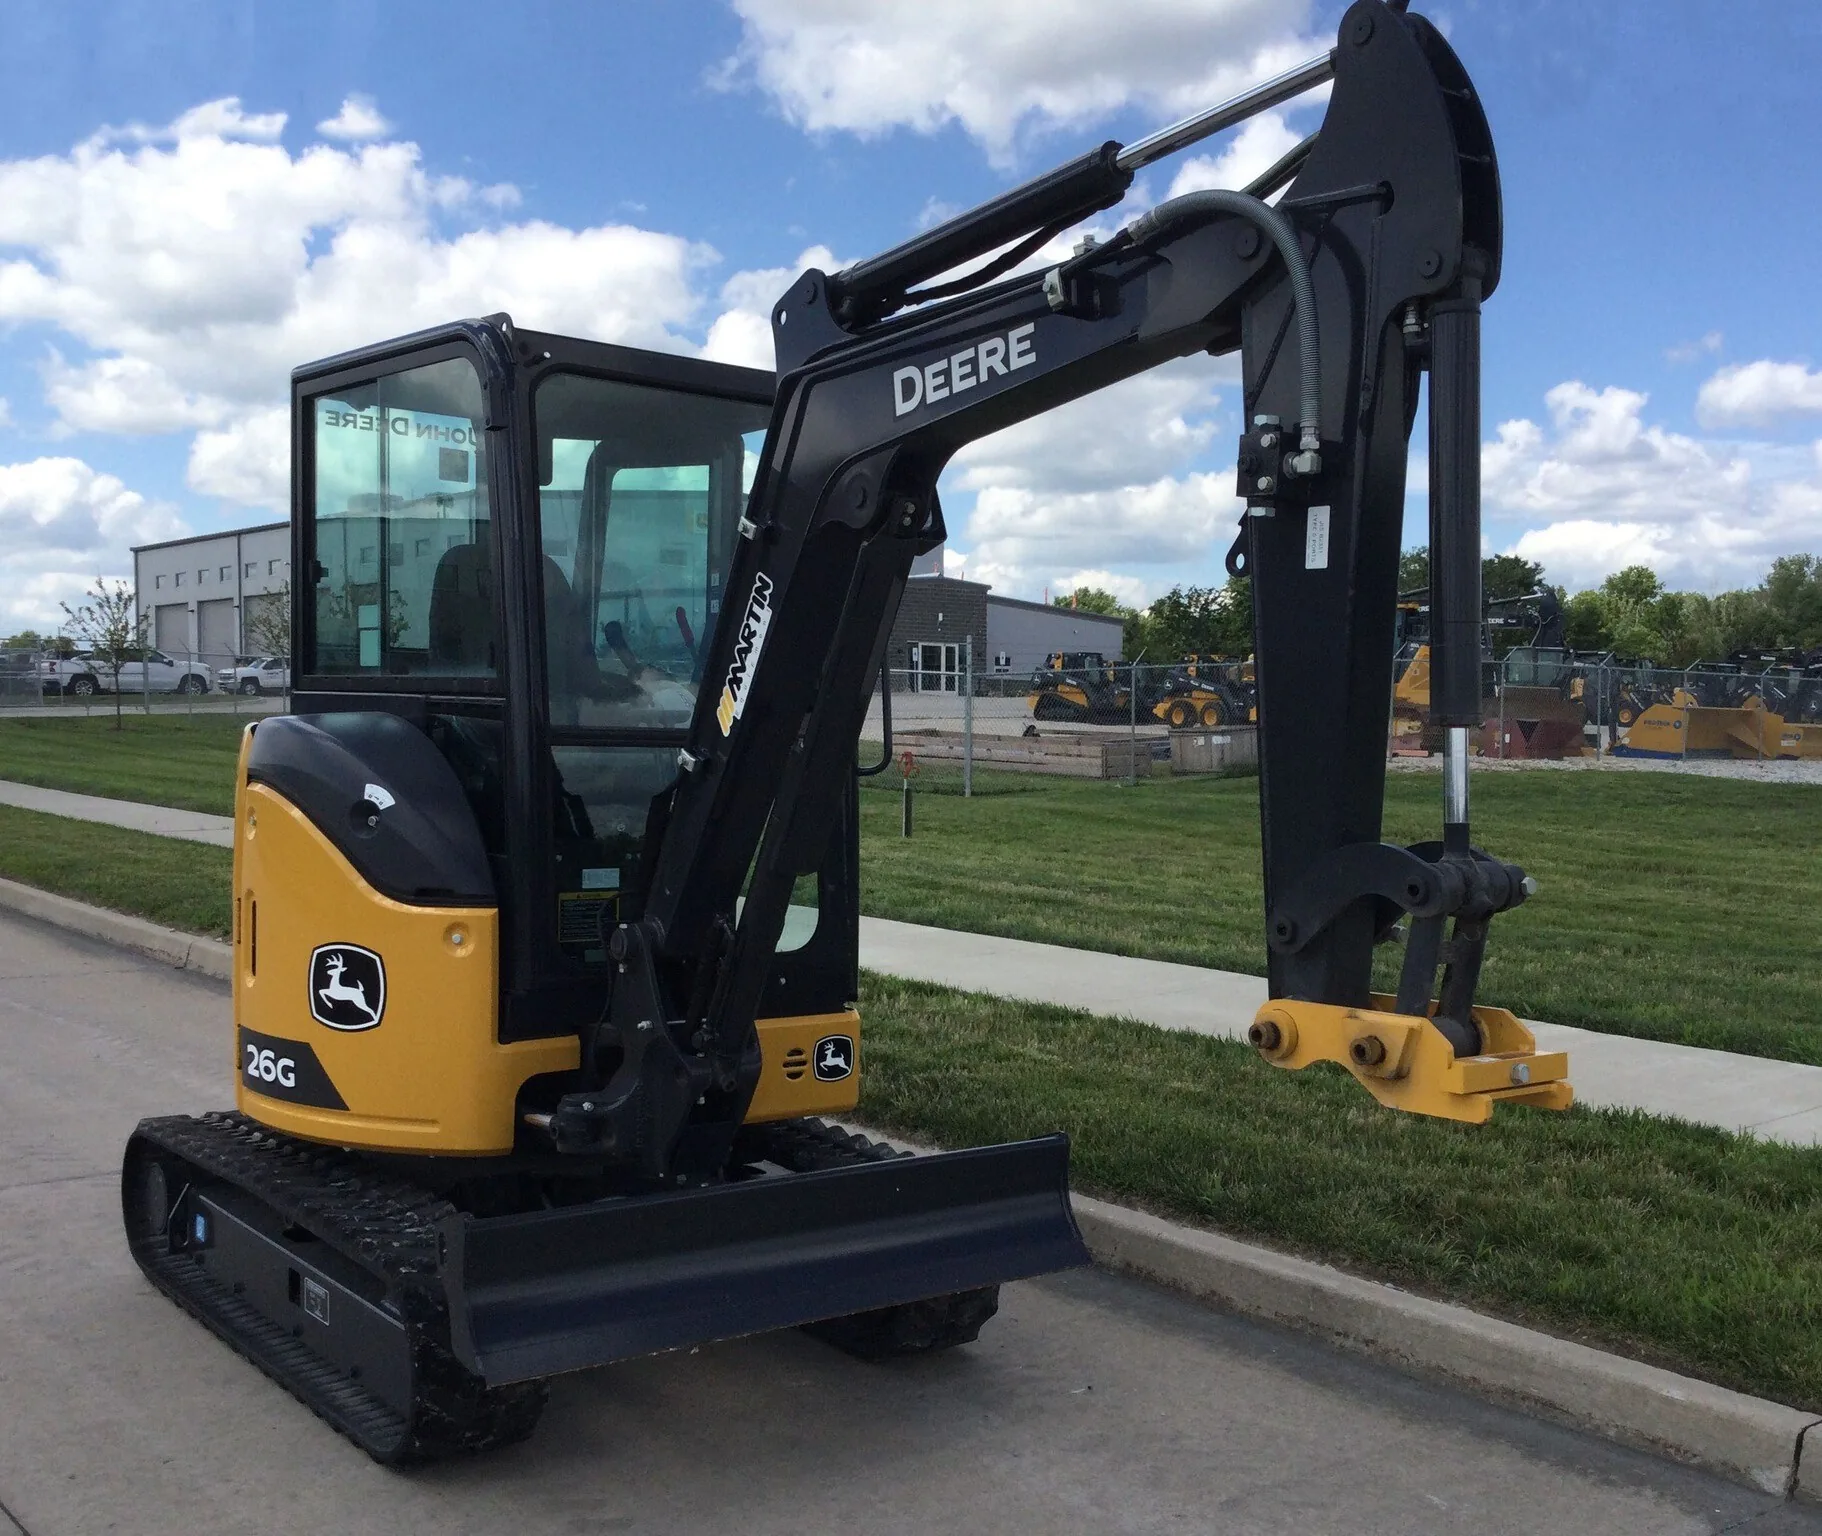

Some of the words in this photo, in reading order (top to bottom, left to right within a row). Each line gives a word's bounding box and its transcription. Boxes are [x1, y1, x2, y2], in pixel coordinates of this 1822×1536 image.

[893, 322, 1036, 416] DEERE
[727, 573, 772, 703] MARTIN
[247, 1044, 296, 1088] 26G
